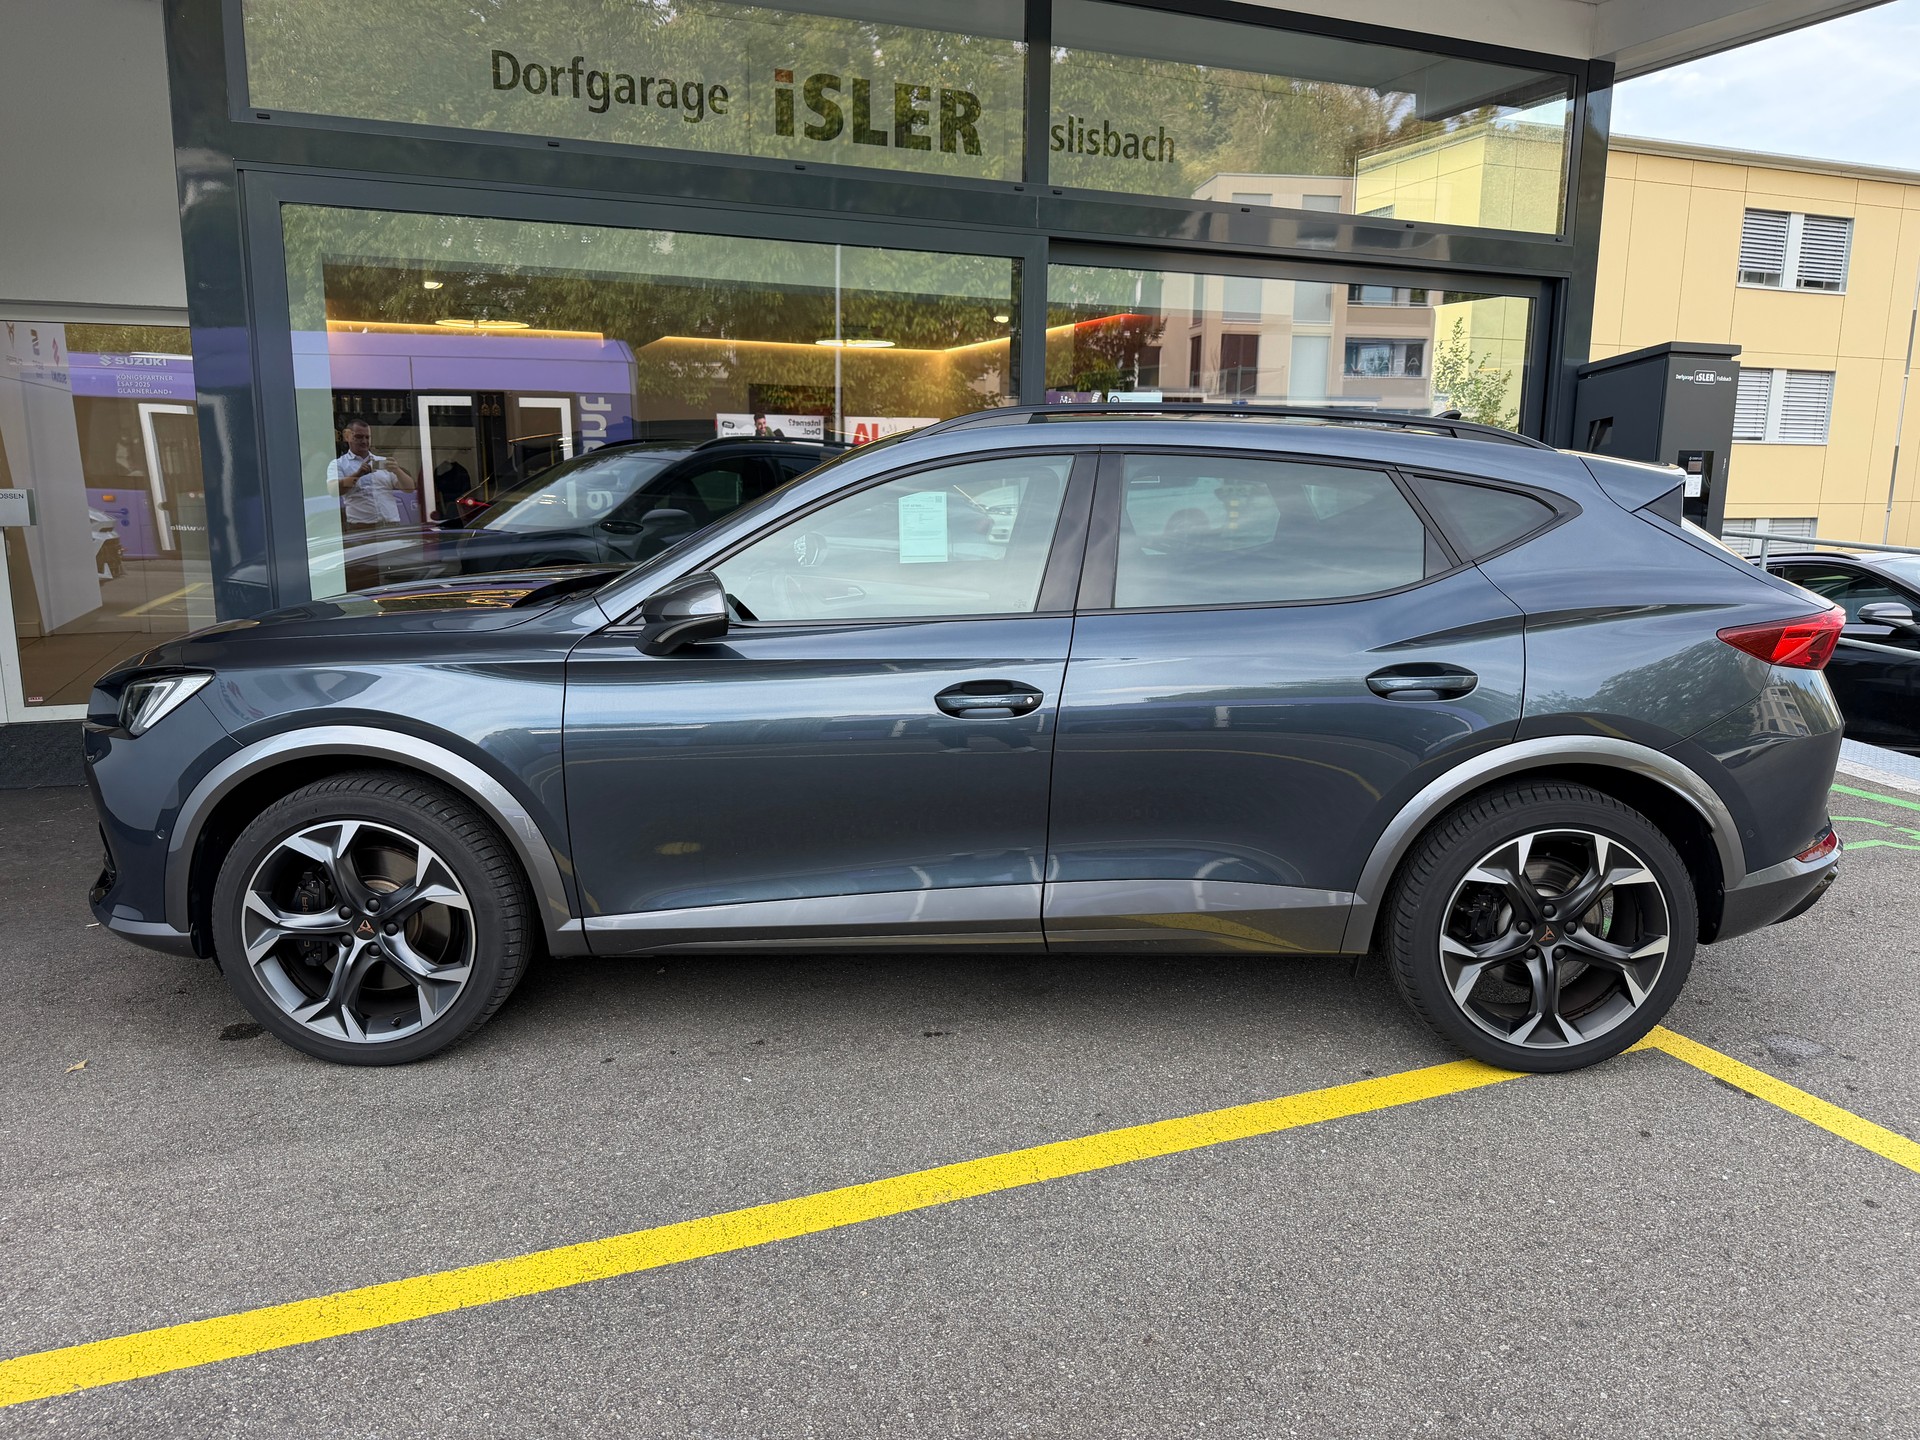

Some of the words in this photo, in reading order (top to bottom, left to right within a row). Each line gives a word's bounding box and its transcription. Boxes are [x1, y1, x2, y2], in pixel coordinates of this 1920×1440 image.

[491, 49, 729, 124] Dorfgarage
[774, 67, 983, 157] iSLER
[1050, 115, 1176, 163] slisbach
[115, 356, 168, 366] SUZUKI
[116, 373, 174, 381] KÖNIGSPARTNER
[1696, 372, 1715, 382] iSLER
